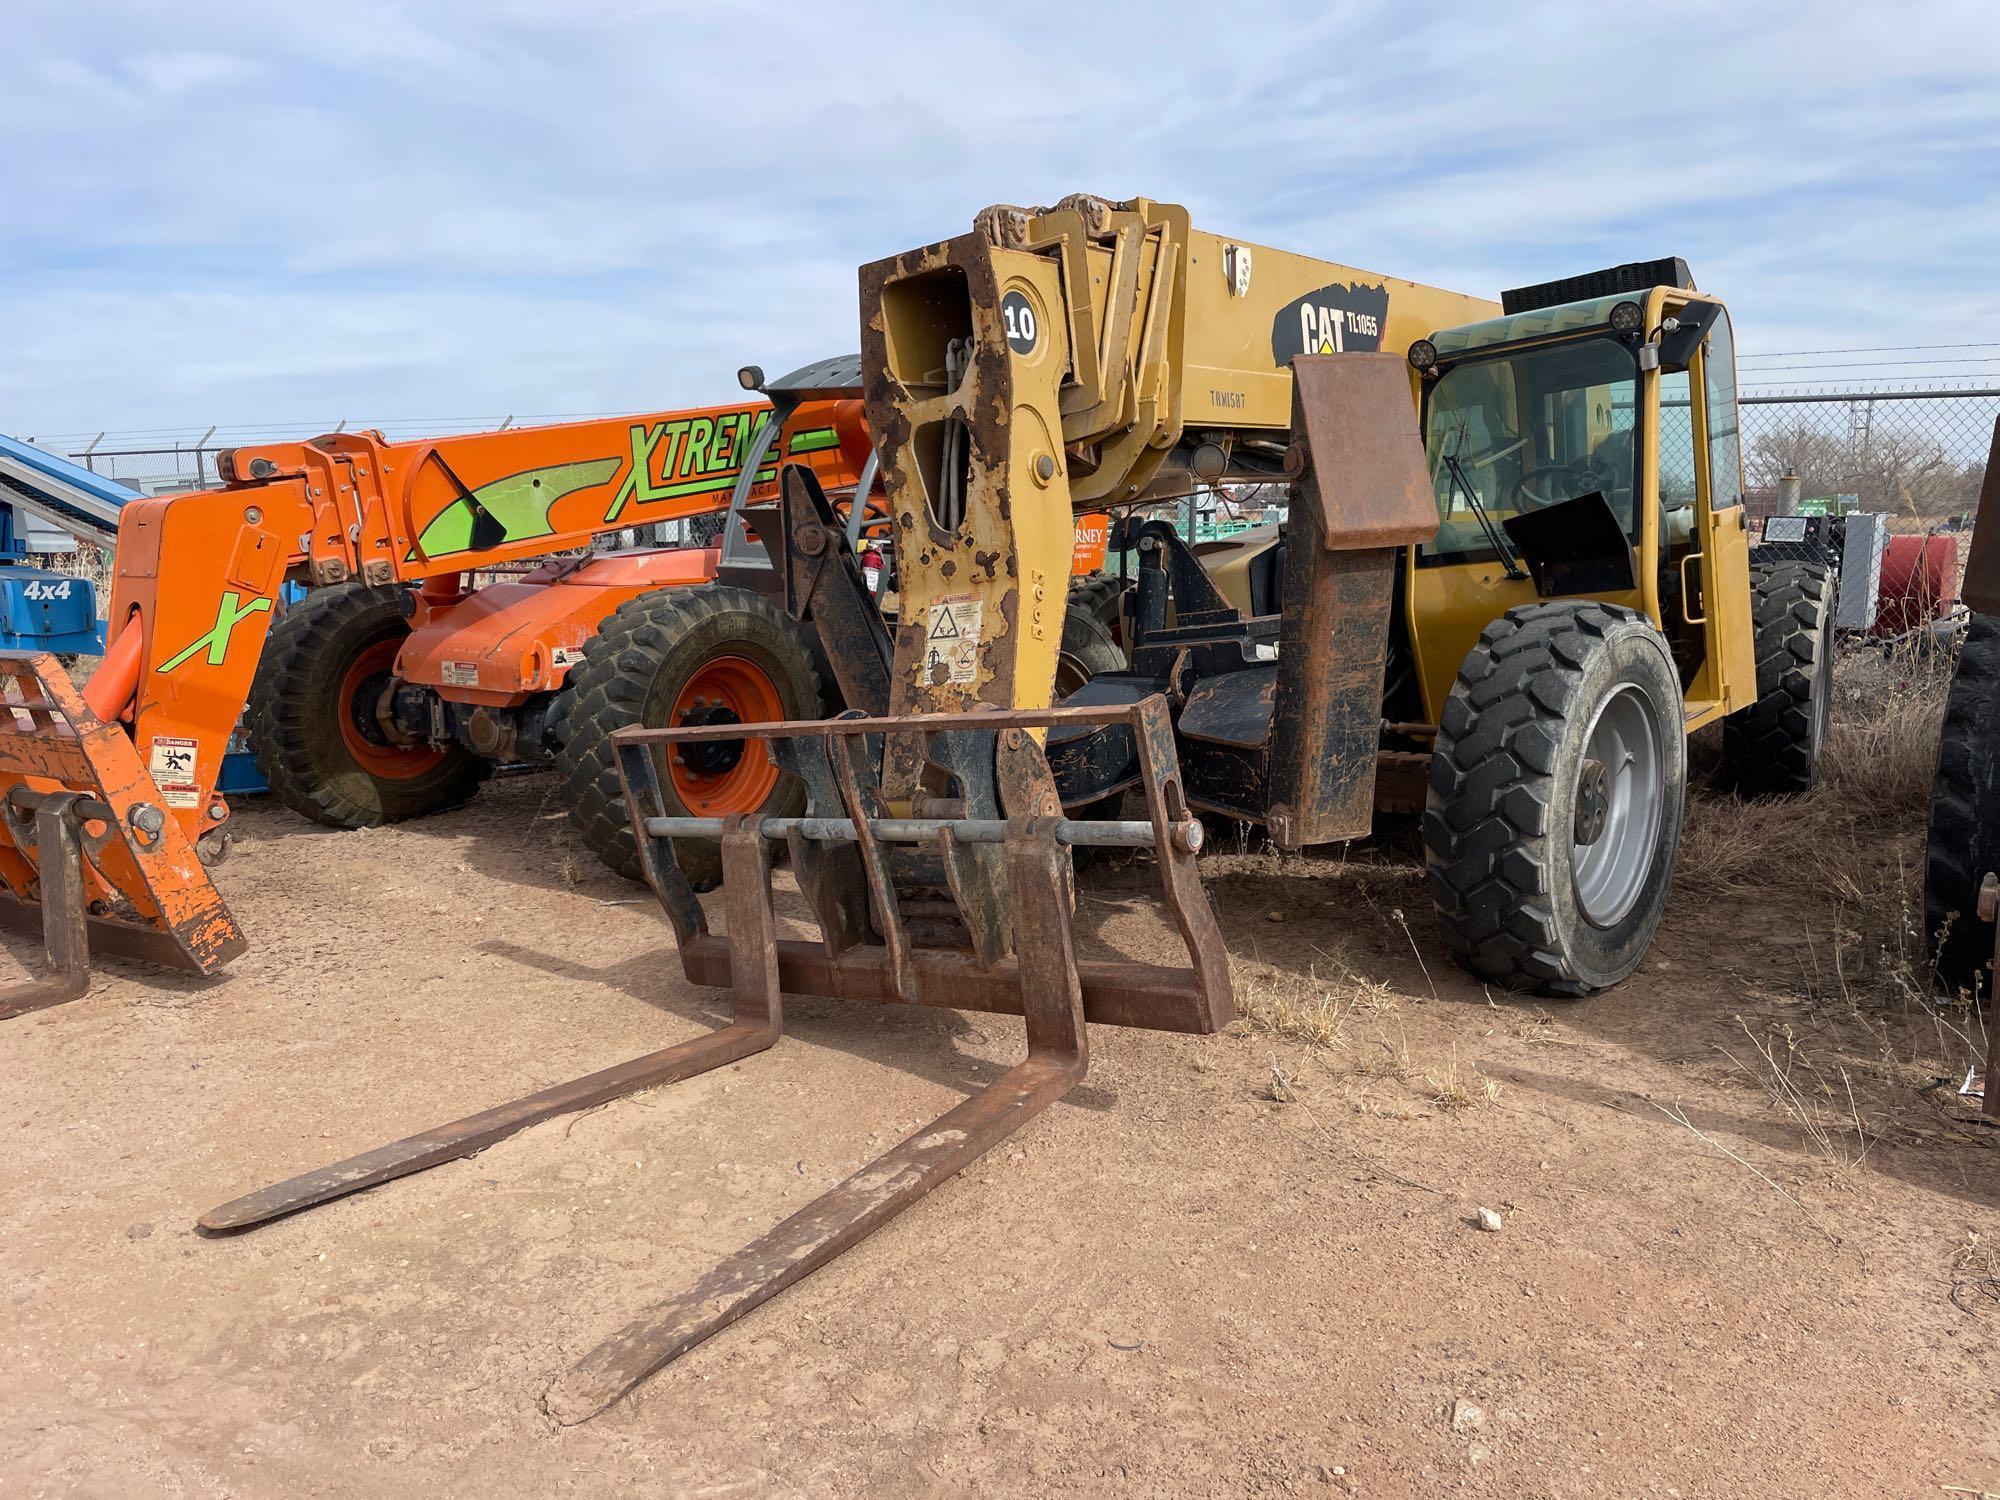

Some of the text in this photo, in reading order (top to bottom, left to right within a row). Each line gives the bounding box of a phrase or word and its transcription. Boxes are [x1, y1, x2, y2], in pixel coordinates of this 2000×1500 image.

[1004, 305, 1035, 340] 10
[1301, 303, 1377, 354] CAT TL1055
[1075, 529, 1103, 543] RNEY
[23, 580, 71, 600] 4x4
[166, 739, 193, 747] DANGER
